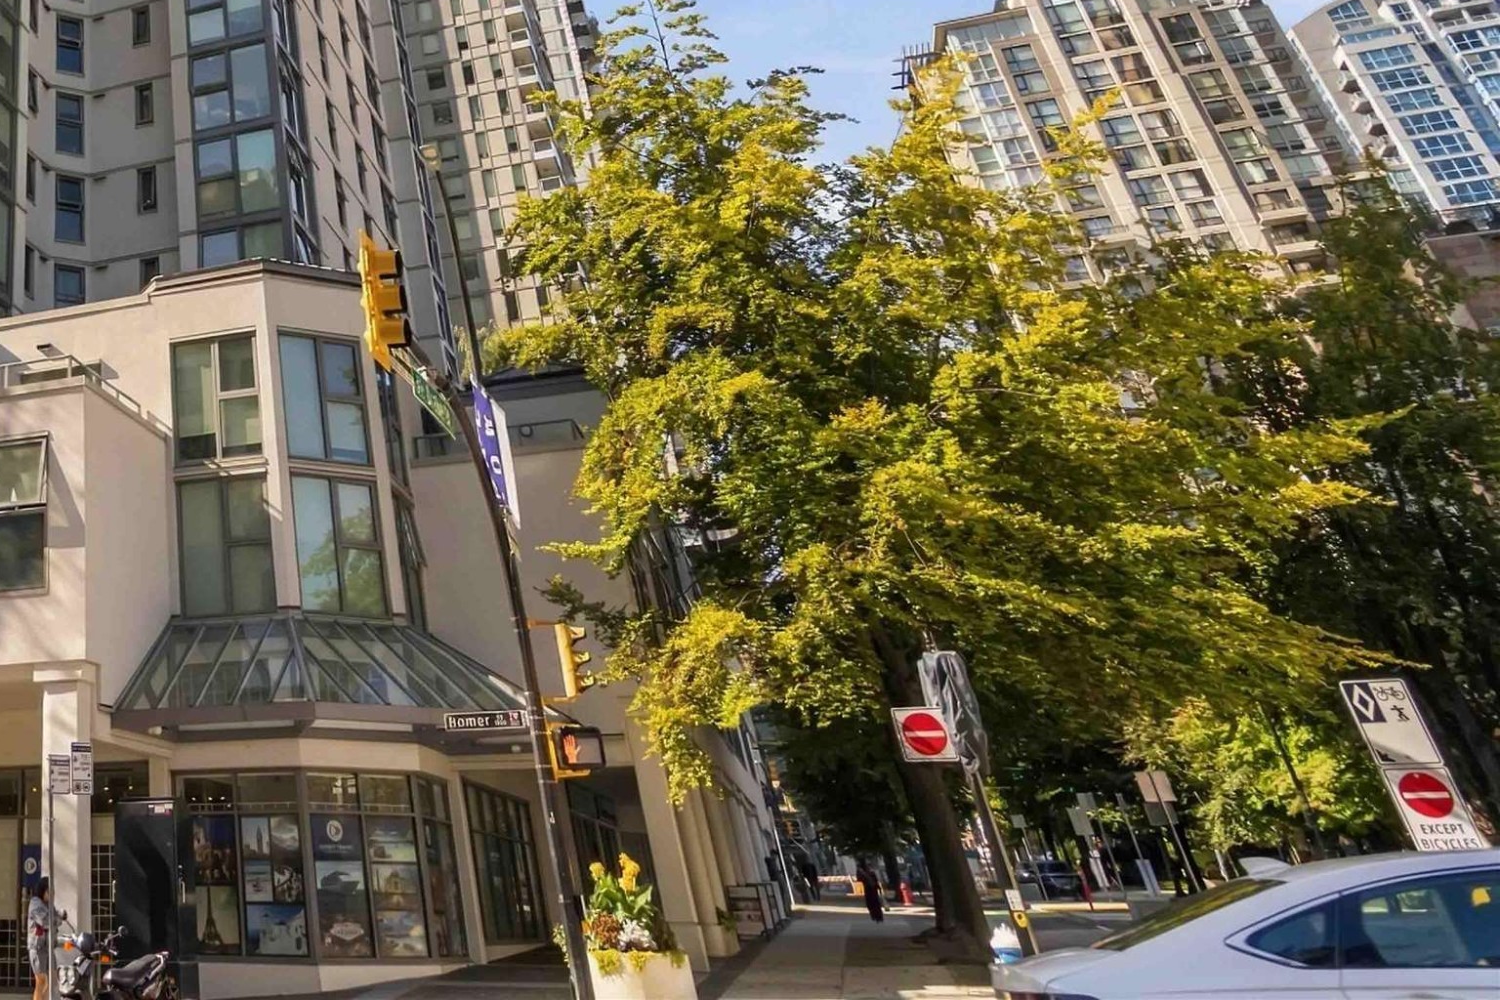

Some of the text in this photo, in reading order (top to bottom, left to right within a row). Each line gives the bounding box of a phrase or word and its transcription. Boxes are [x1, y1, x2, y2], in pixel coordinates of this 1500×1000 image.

[448, 715, 490, 728] Homer
[1419, 823, 1466, 835] EXCEPT
[1420, 838, 1480, 851] BICYCLES
